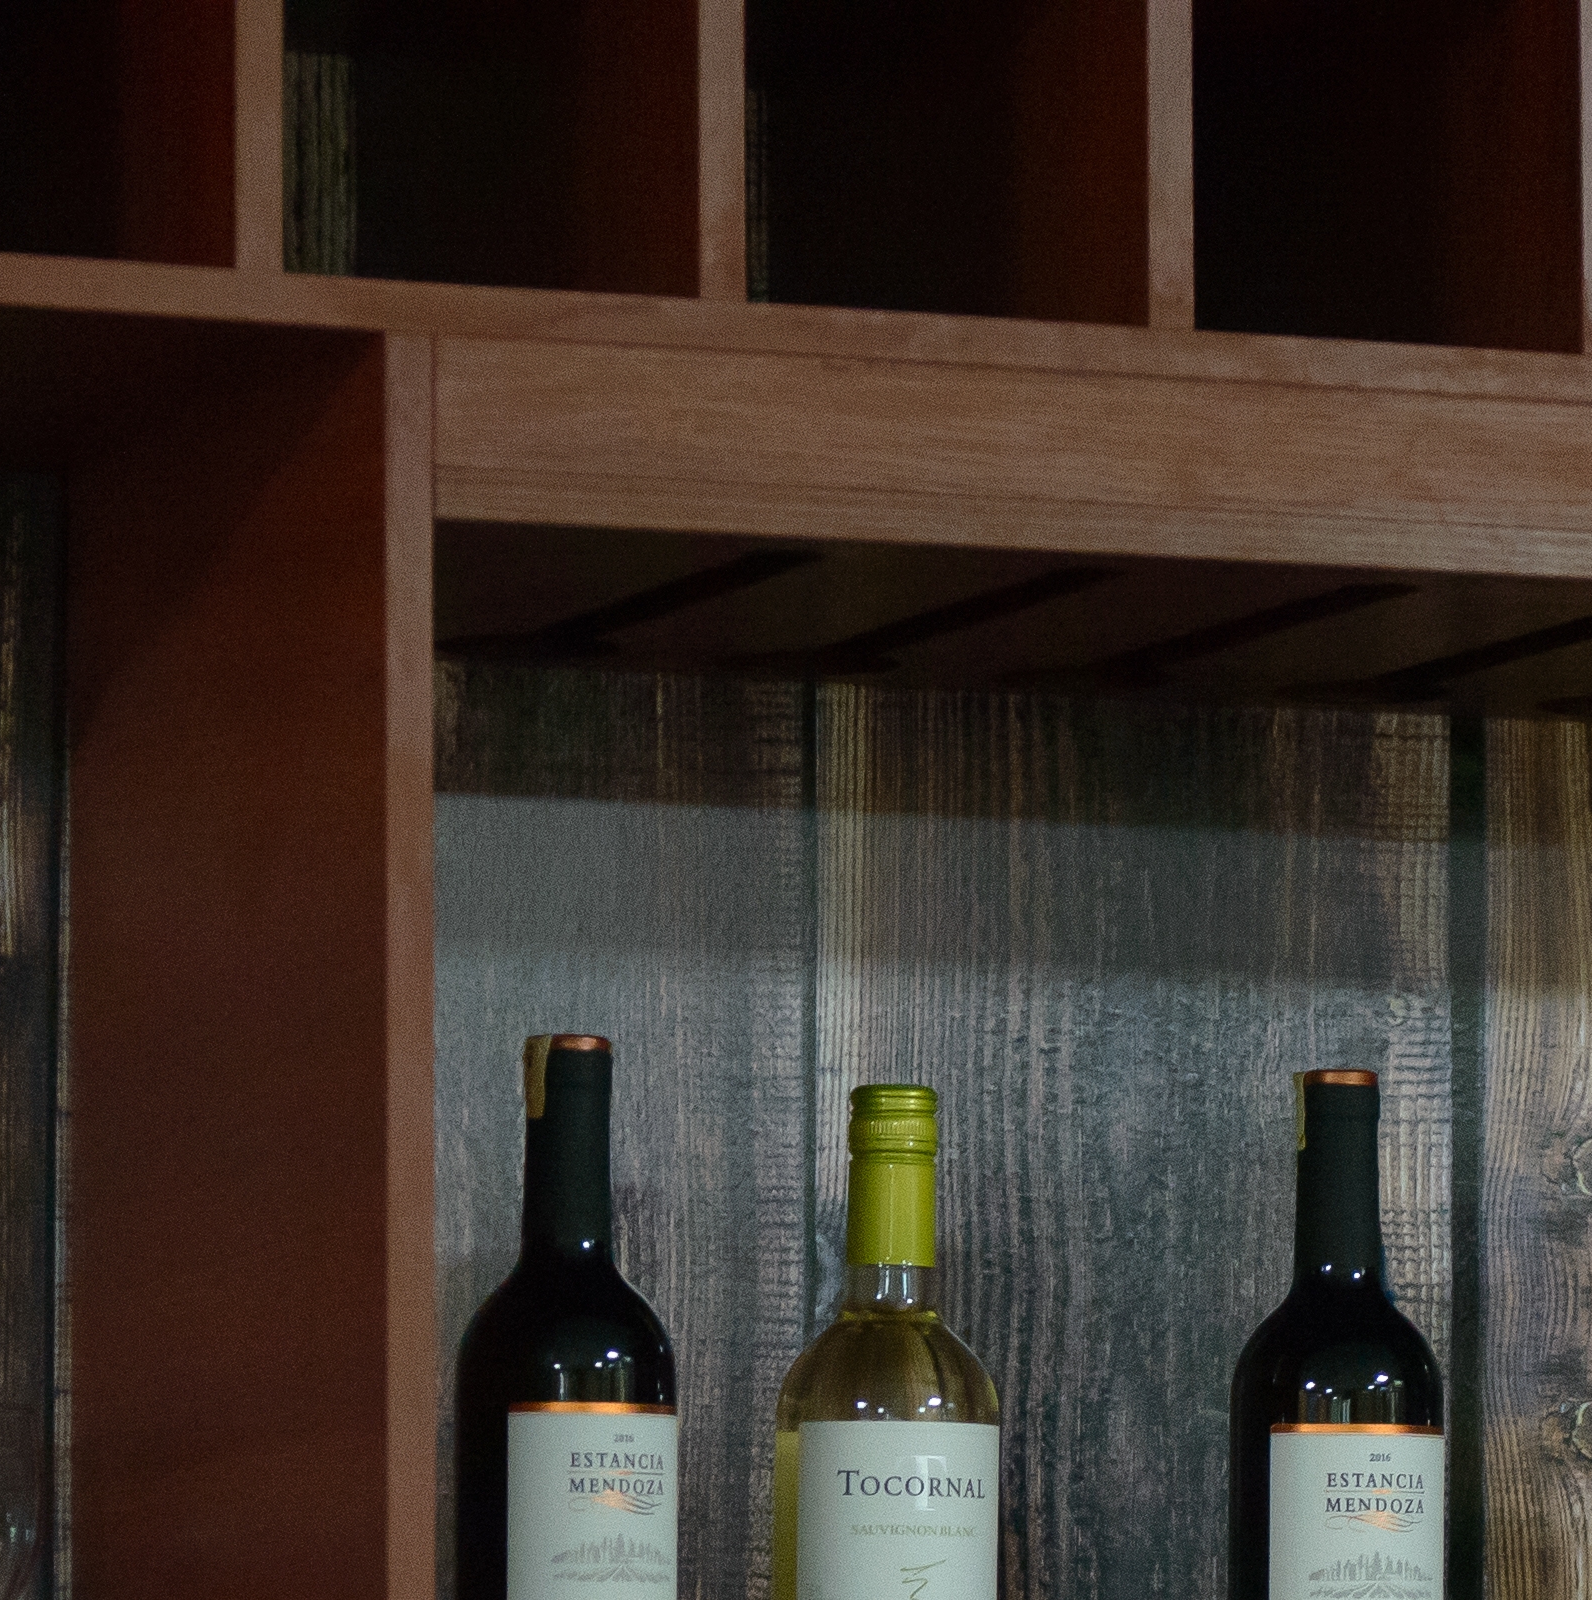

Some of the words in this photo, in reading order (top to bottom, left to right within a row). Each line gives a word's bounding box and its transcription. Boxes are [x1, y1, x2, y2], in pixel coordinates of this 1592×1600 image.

[570, 1452, 664, 1470] ESTANCIA
[1369, 1453, 1391, 1462] 2016
[568, 1477, 664, 1496] MENDOZA
[837, 1470, 985, 1499] TOCORNAL
[1326, 1472, 1424, 1489] ESTANCIA
[1325, 1498, 1424, 1513] MENDOZA
[850, 1524, 938, 1536] SAUVIGNON
[940, 1526, 975, 1537] BLANC
